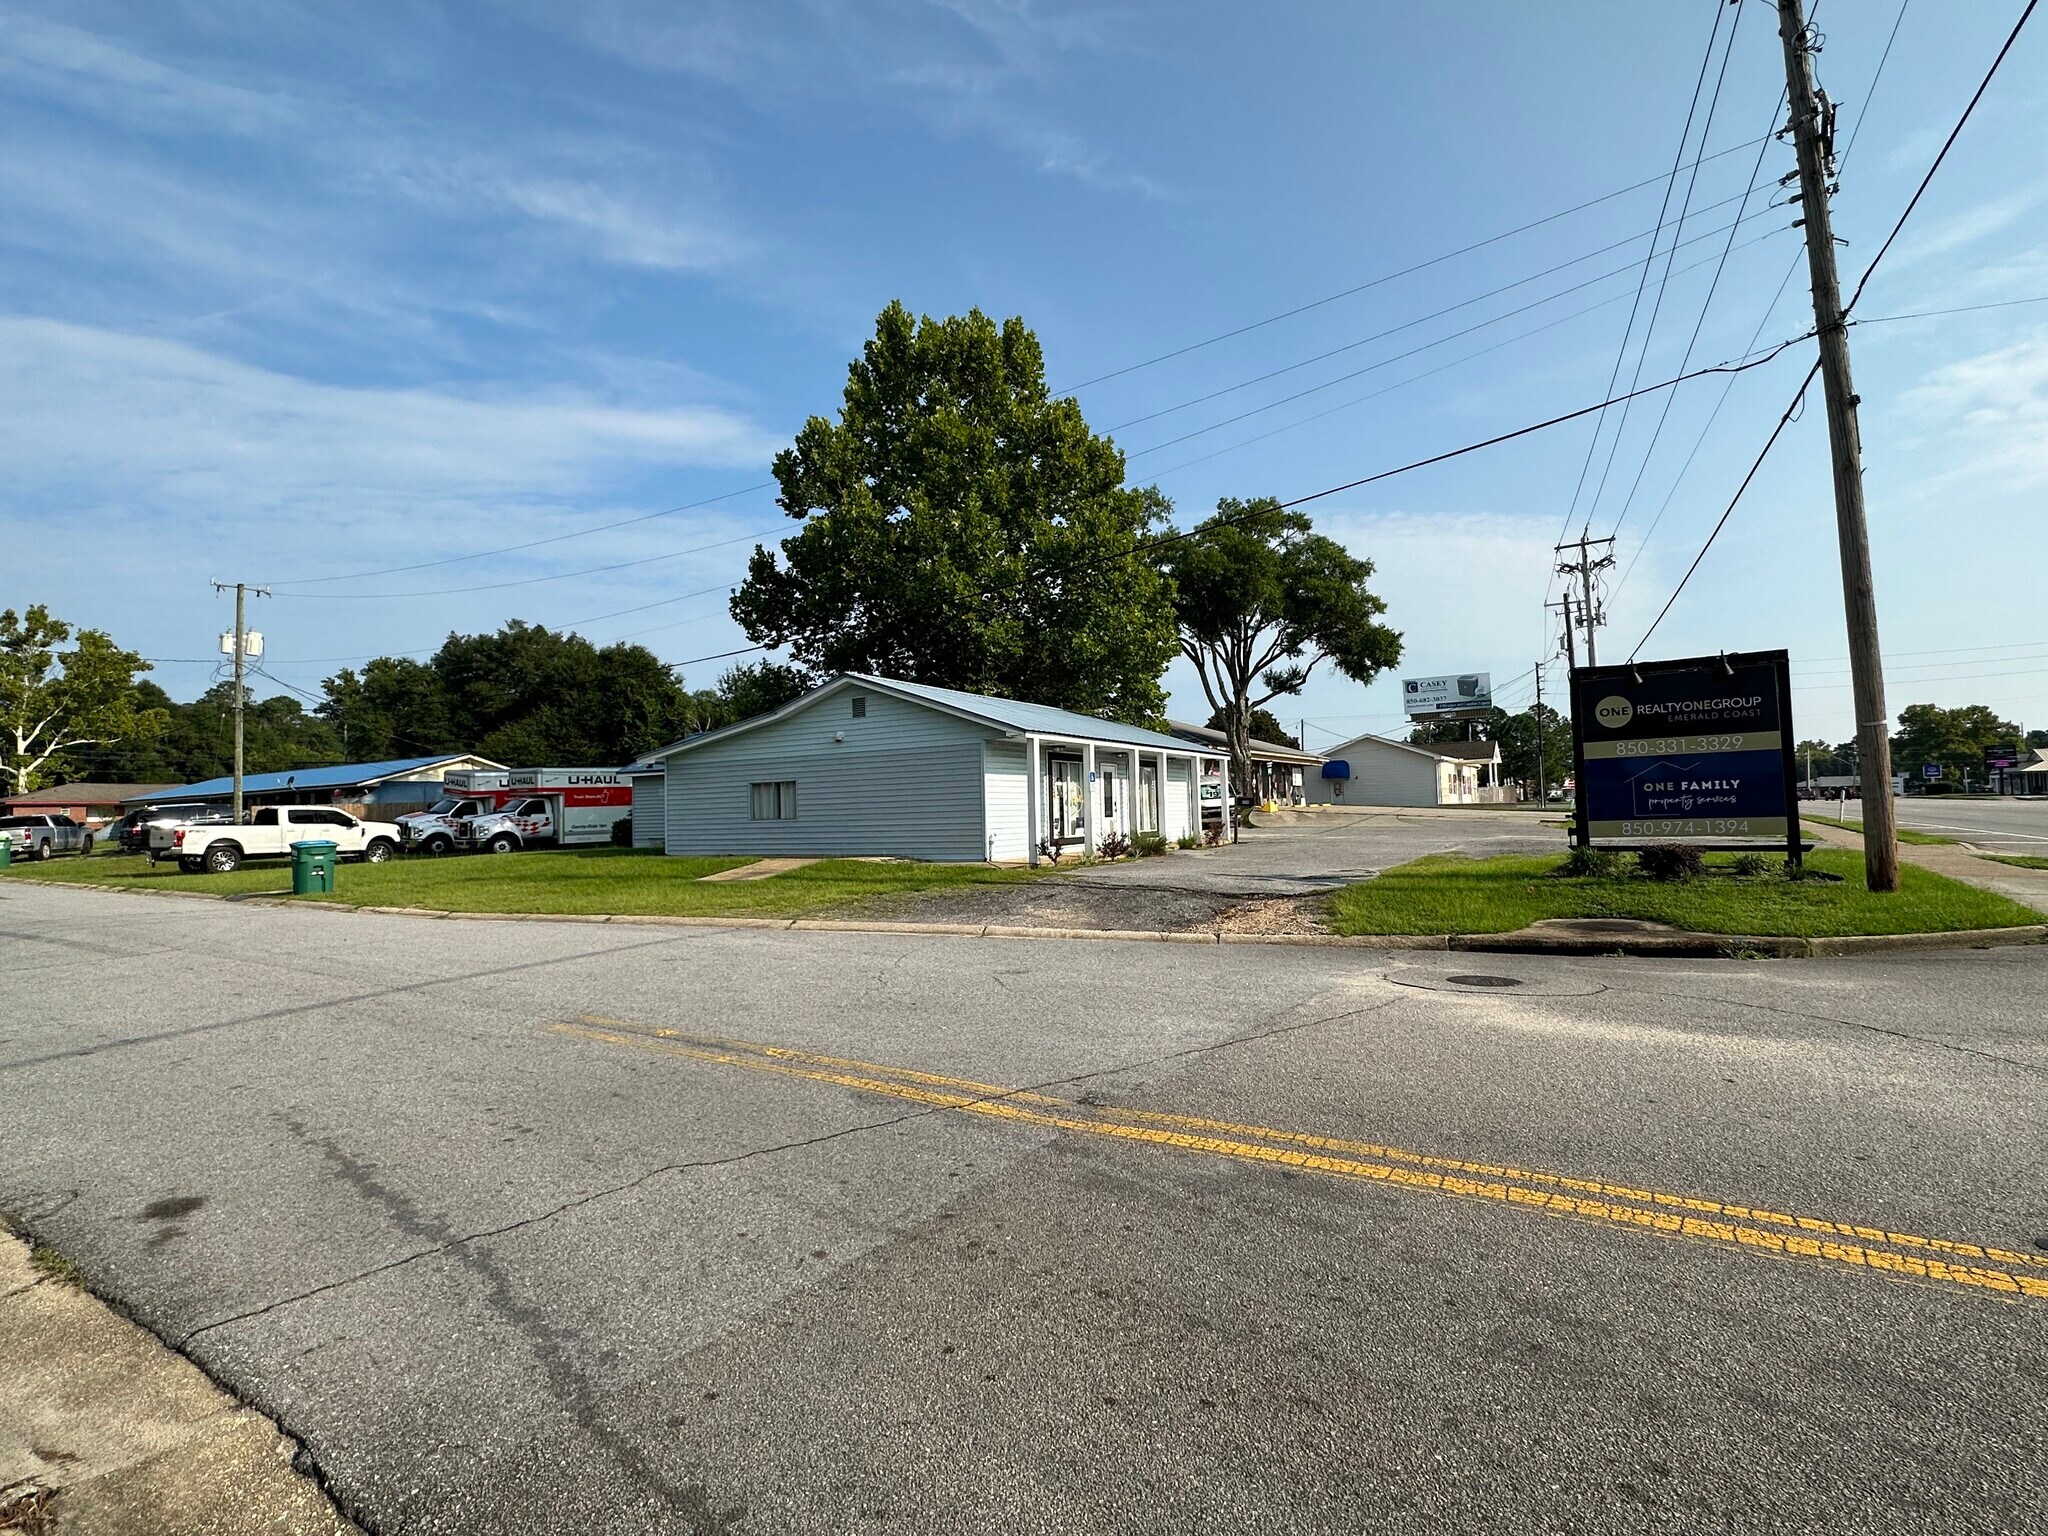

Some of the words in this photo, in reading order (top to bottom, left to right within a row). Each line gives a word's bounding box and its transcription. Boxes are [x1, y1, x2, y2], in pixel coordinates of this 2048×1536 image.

[1420, 680, 1447, 688] CASEY
[1599, 706, 1630, 717] ONE
[1637, 696, 1762, 715] REALTYONEGROUP
[1667, 711, 1719, 723] EMERALD
[1723, 708, 1762, 718] COAST
[1616, 735, 1743, 756] 850-331-3329
[445, 778, 468, 788] U-HAUL
[511, 776, 535, 785] U-HAUL
[568, 775, 621, 784] U-HAUL
[1643, 782, 1675, 792] ONE
[1681, 779, 1740, 791] FAMILY
[1648, 794, 1694, 811] property
[1696, 794, 1737, 805] services
[1622, 820, 1750, 836] 850-974-1394
